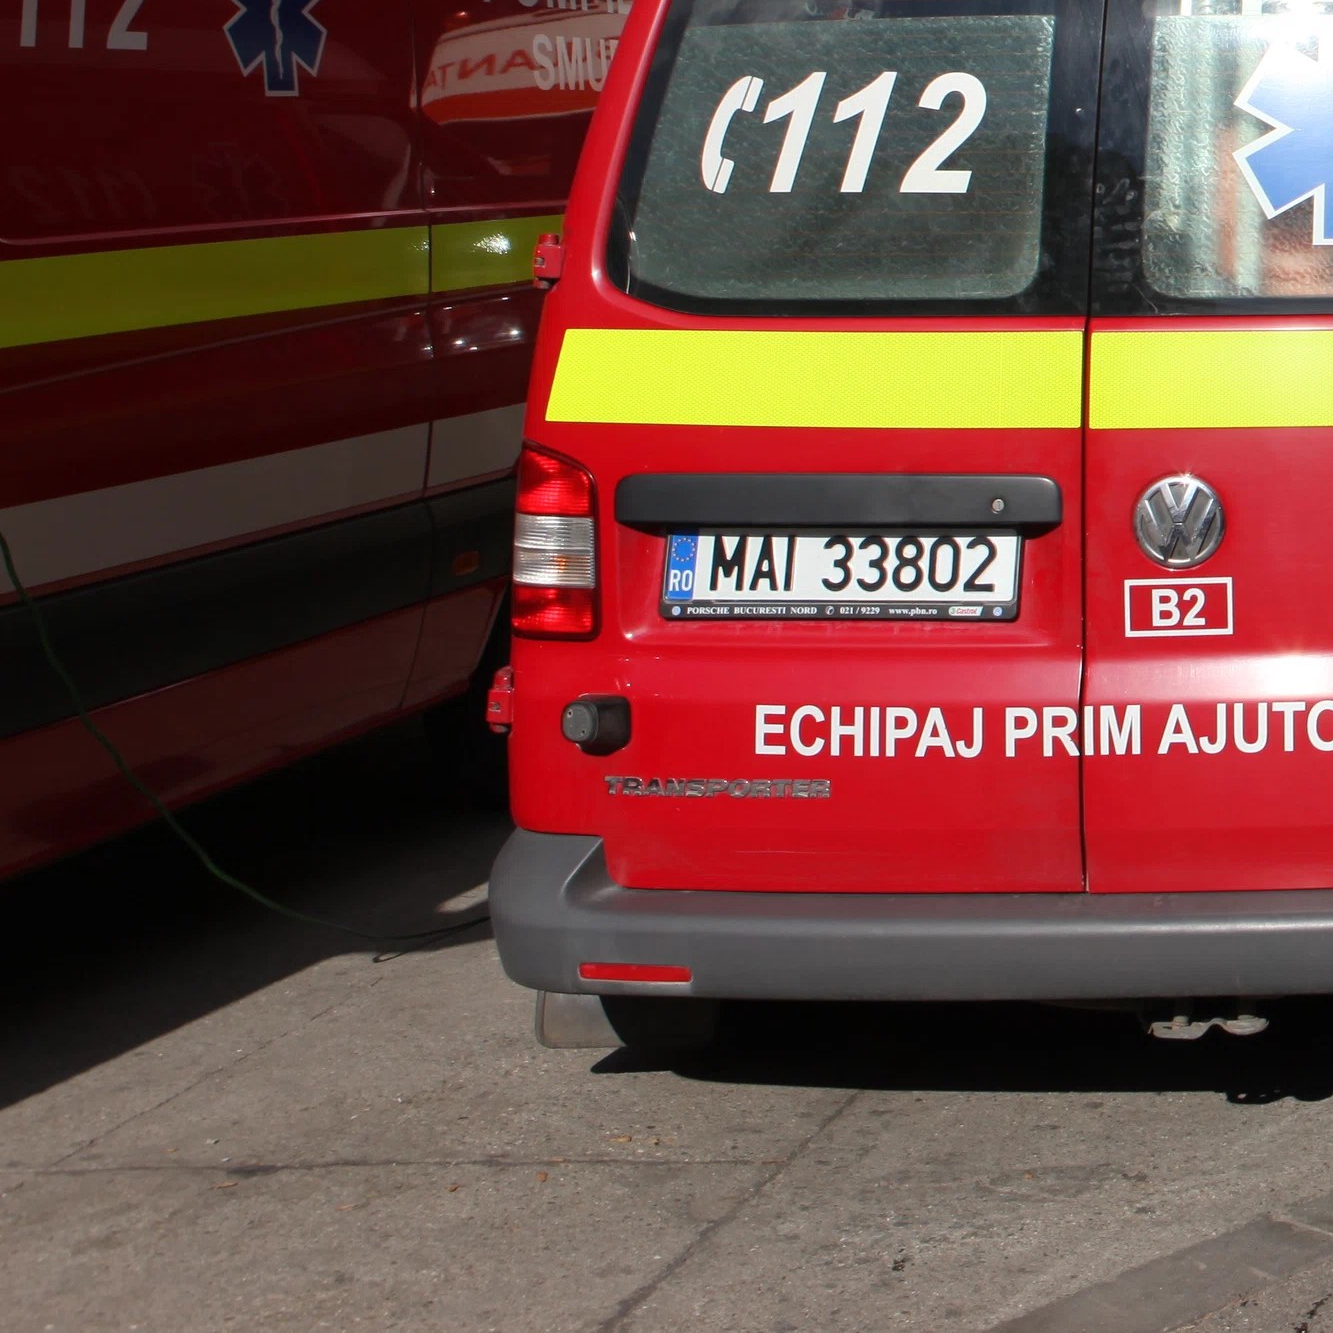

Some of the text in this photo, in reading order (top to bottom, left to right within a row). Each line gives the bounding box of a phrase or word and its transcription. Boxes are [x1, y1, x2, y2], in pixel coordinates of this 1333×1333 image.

[533, 34, 619, 91] SMU
[761, 71, 989, 195] 112
[668, 534, 998, 593] RO MAI 33802
[686, 606, 730, 615] PORSCHE
[733, 606, 786, 616] BUCURESTI
[790, 606, 817, 616] NORD
[888, 607, 937, 617] www.pbn.ro
[1151, 587, 1206, 627] B2
[754, 704, 983, 758] ECHIPAJ
[1005, 703, 1141, 758] PRIM
[604, 775, 832, 798] TRANSPORTER
